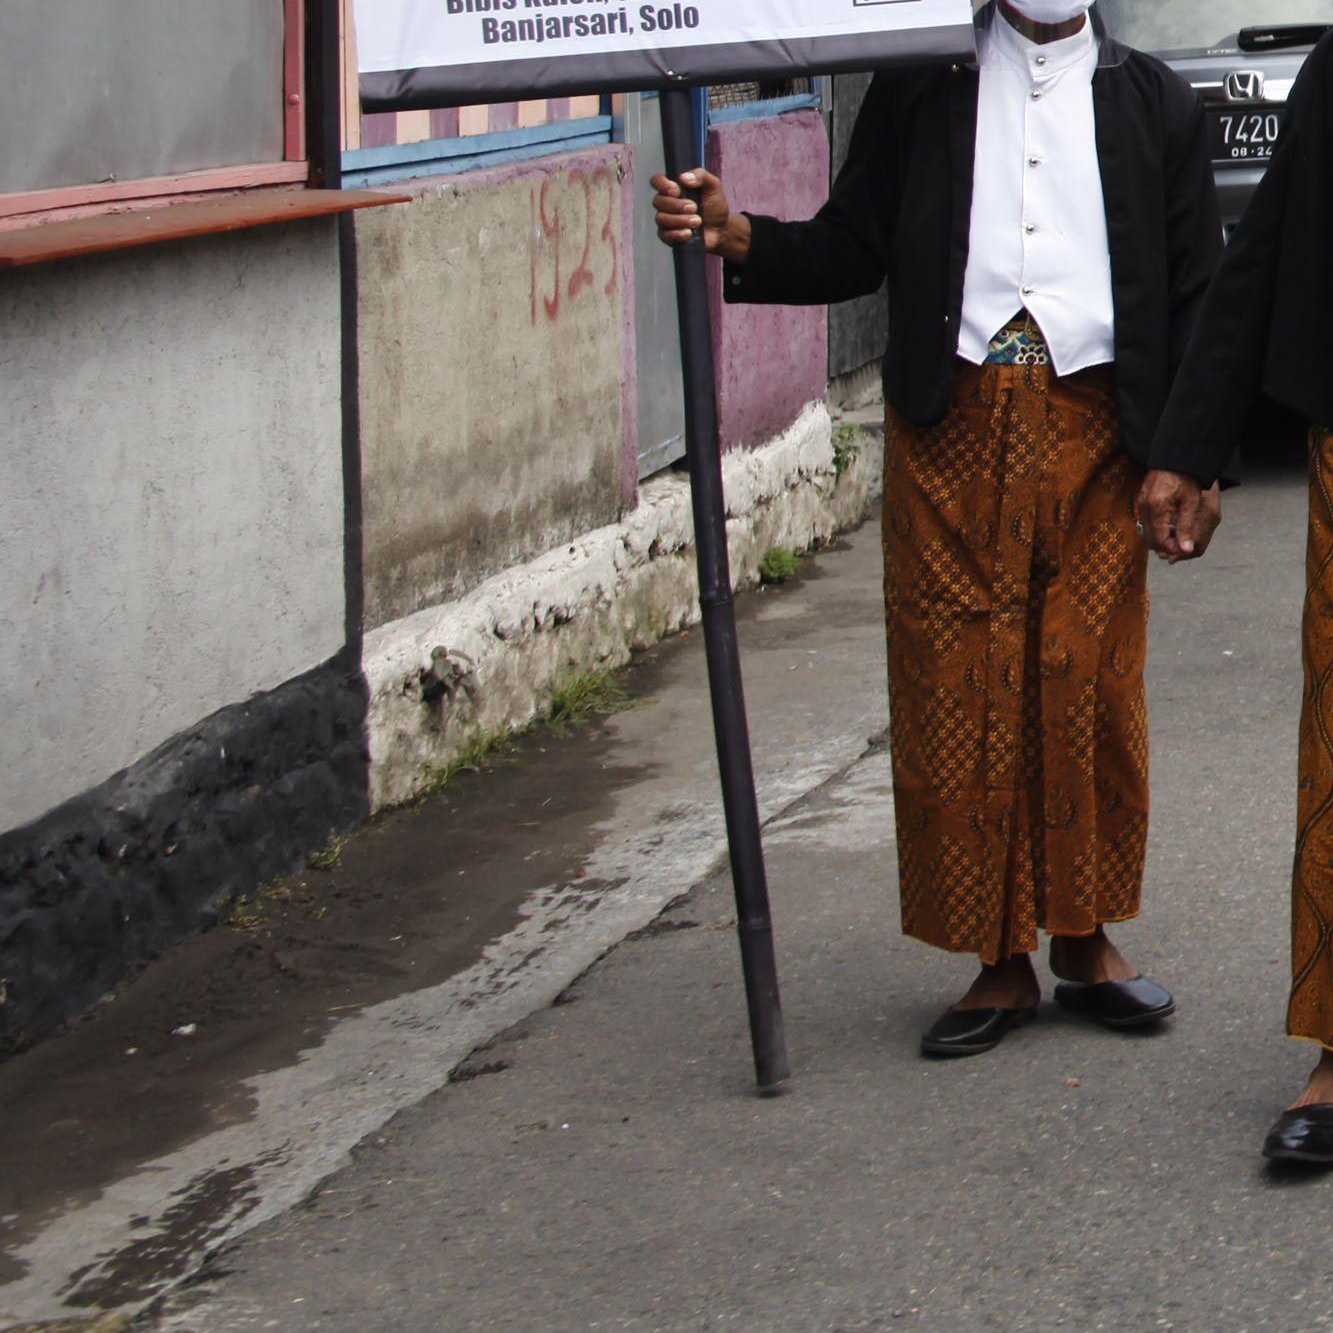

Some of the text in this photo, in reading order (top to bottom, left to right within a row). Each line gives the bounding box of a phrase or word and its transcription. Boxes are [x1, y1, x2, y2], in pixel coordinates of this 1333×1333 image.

[482, 2, 700, 44] Banjarsari, Solo
[1220, 114, 1278, 144] 7420
